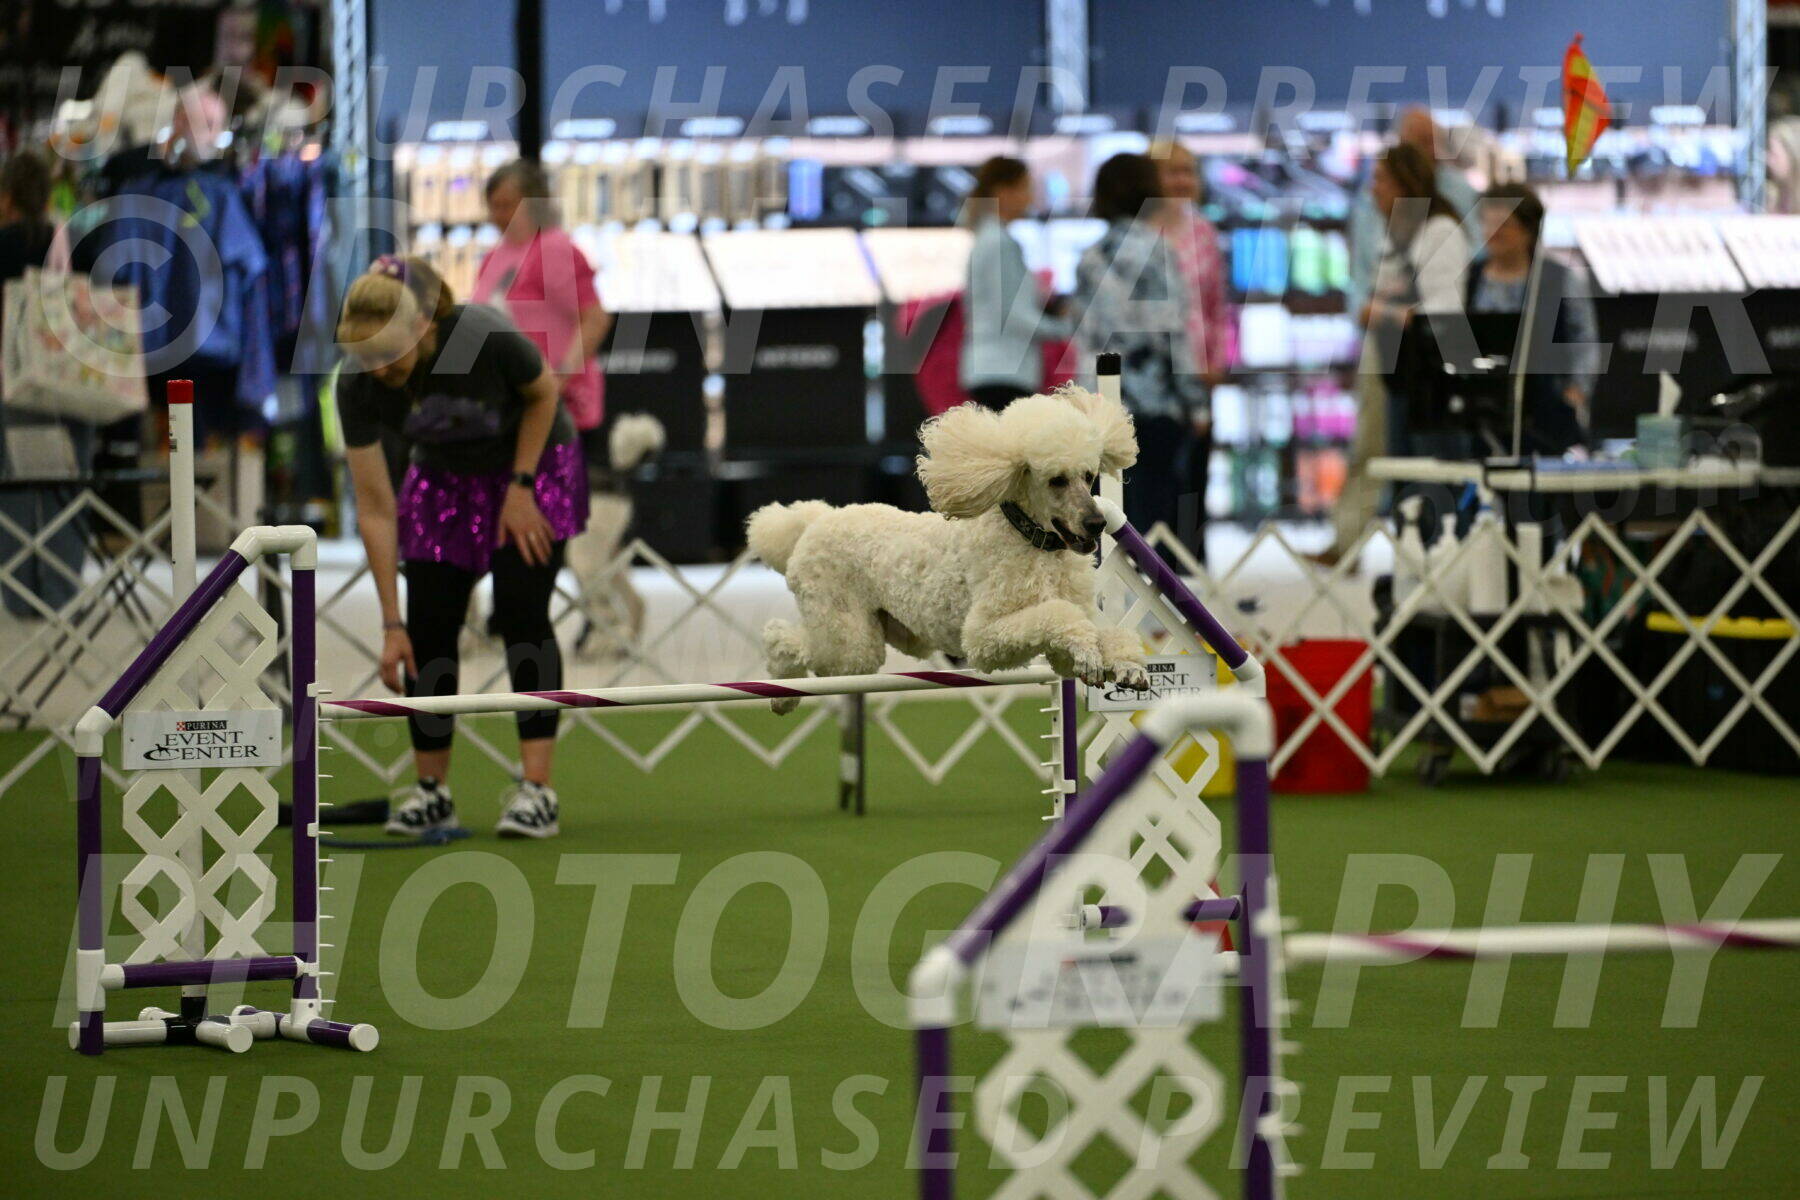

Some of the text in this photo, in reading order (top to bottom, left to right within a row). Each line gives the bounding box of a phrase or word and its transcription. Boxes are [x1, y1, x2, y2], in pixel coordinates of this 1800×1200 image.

[1149, 673, 1189, 686] ENT
[186, 720, 227, 731] PURINA
[164, 731, 243, 746] EVENT
[143, 746, 260, 761] CENTER
